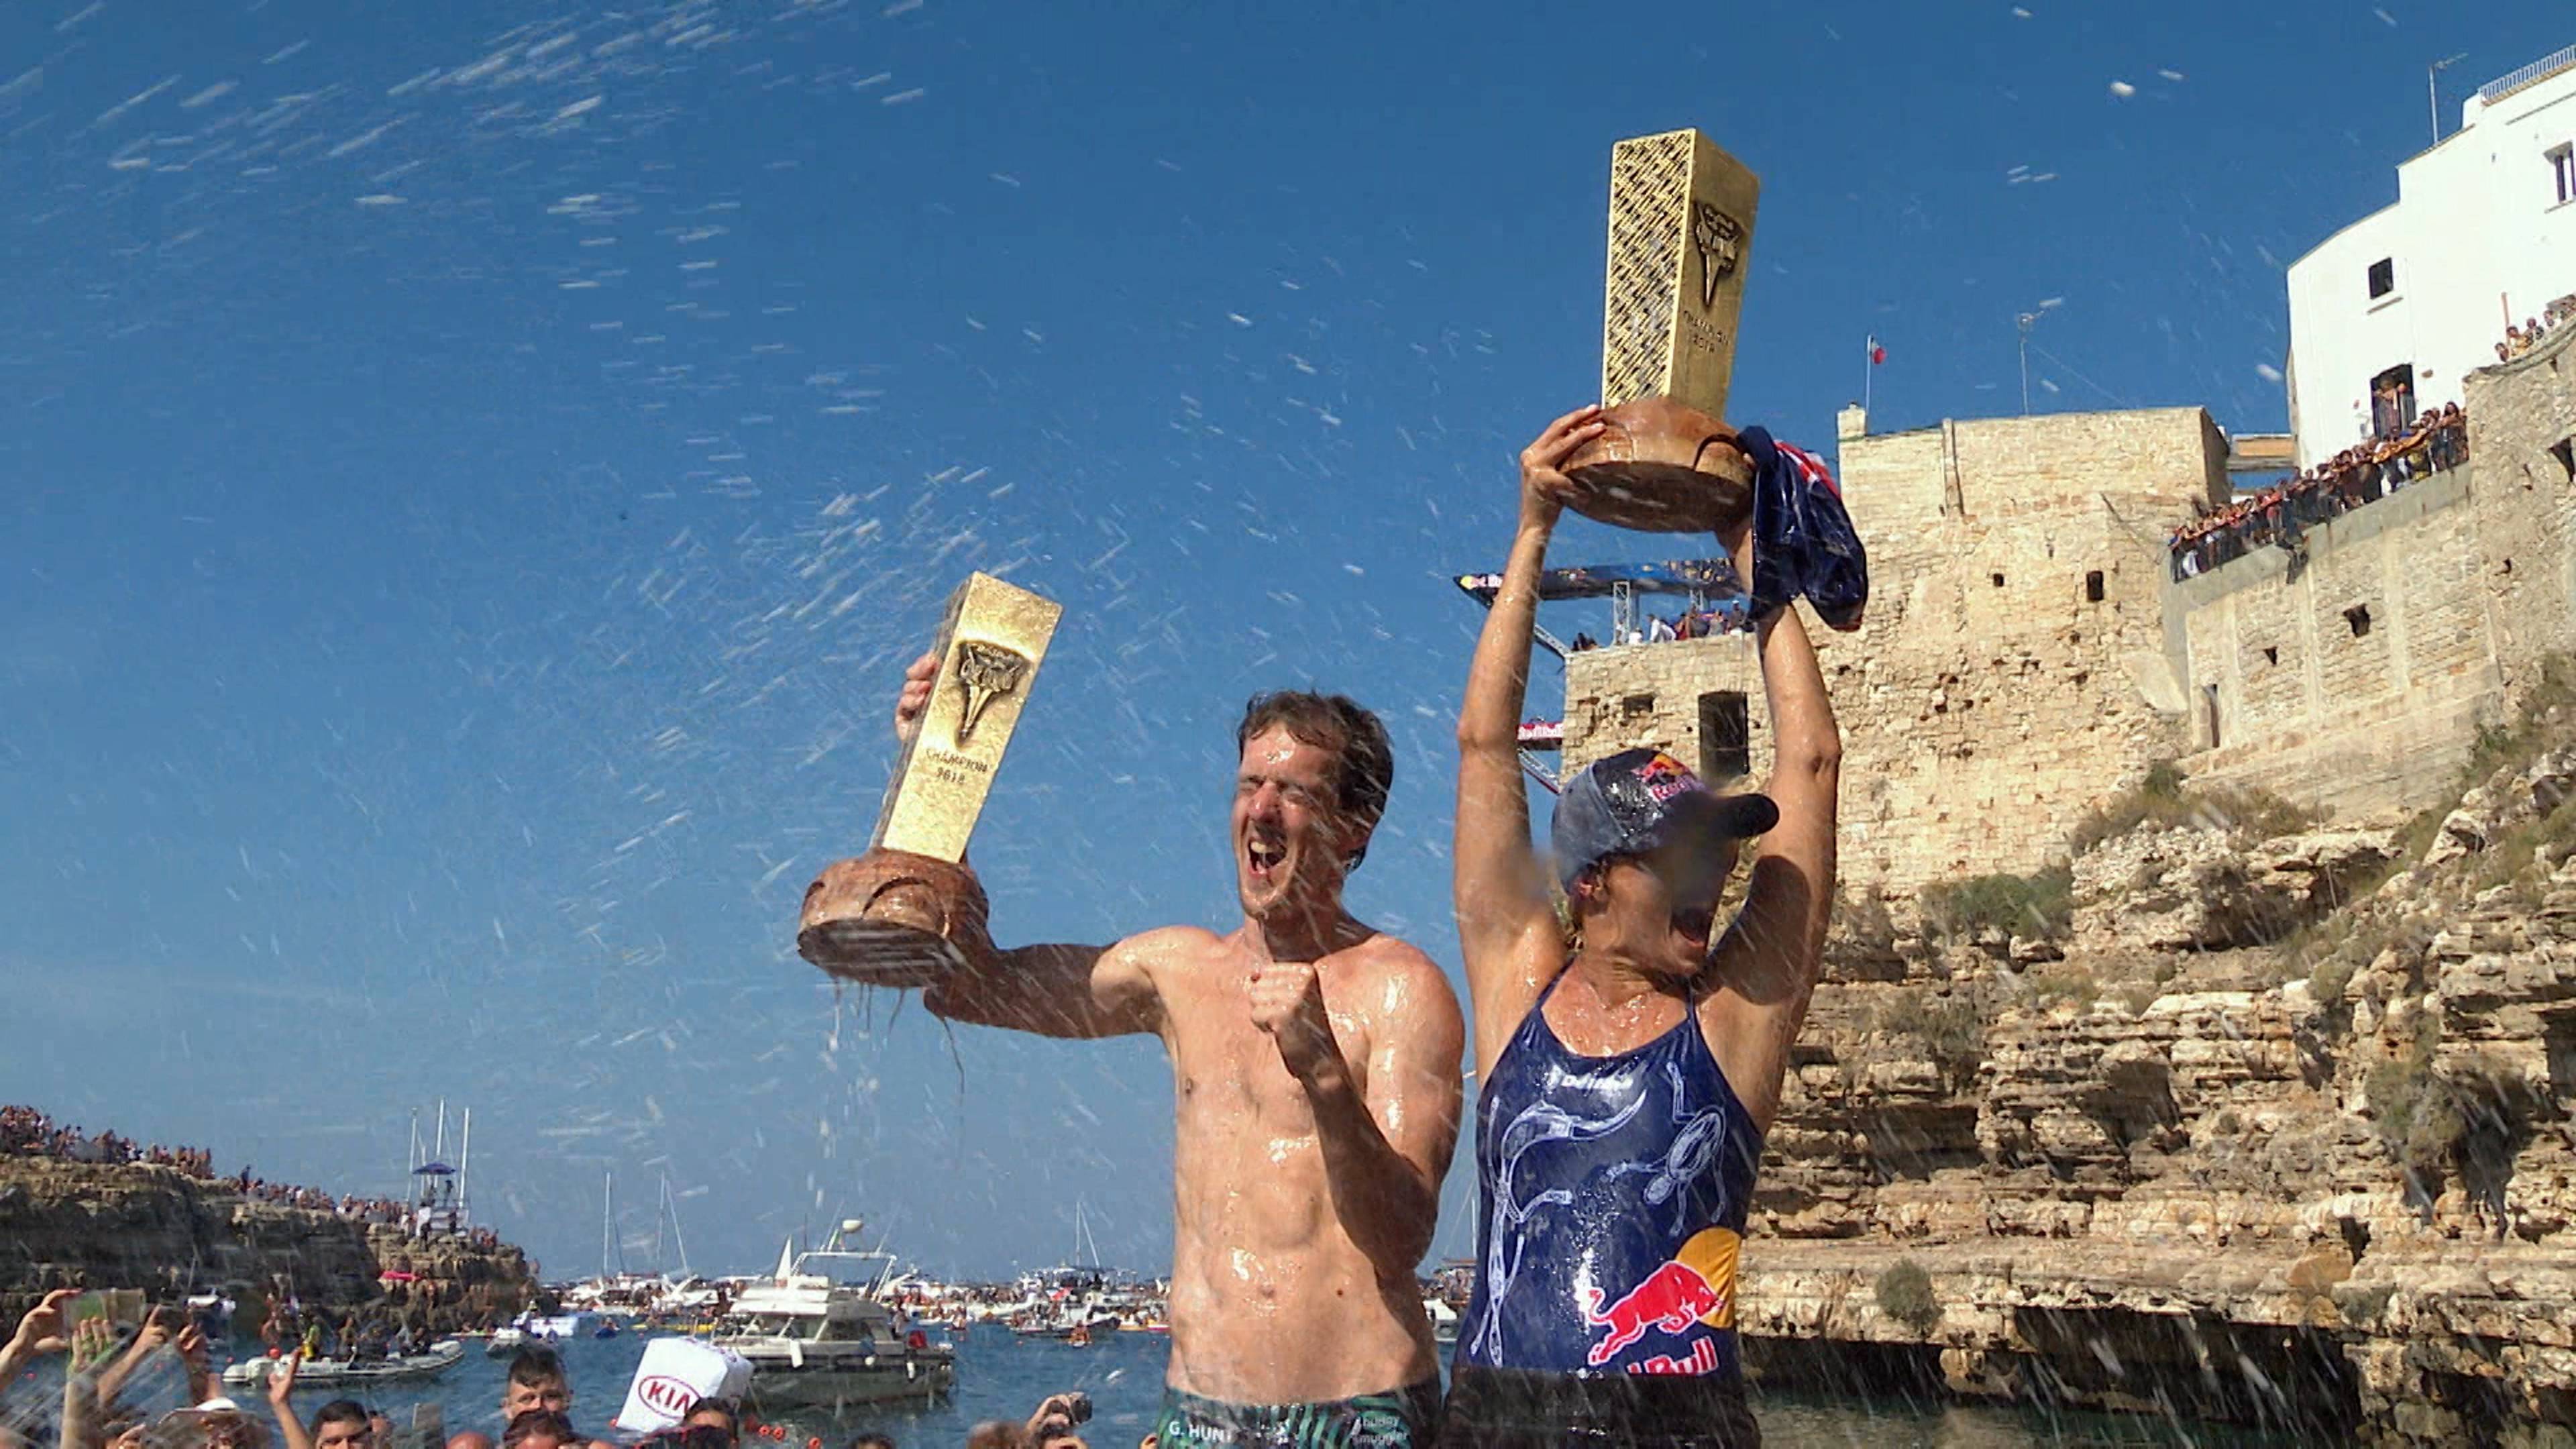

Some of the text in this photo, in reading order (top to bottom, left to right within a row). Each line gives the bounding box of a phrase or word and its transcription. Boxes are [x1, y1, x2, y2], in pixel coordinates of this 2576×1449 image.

[926, 748, 988, 774] CHAMPION
[647, 1381, 691, 1414] KIA
[1169, 1419, 1186, 1436] G.
